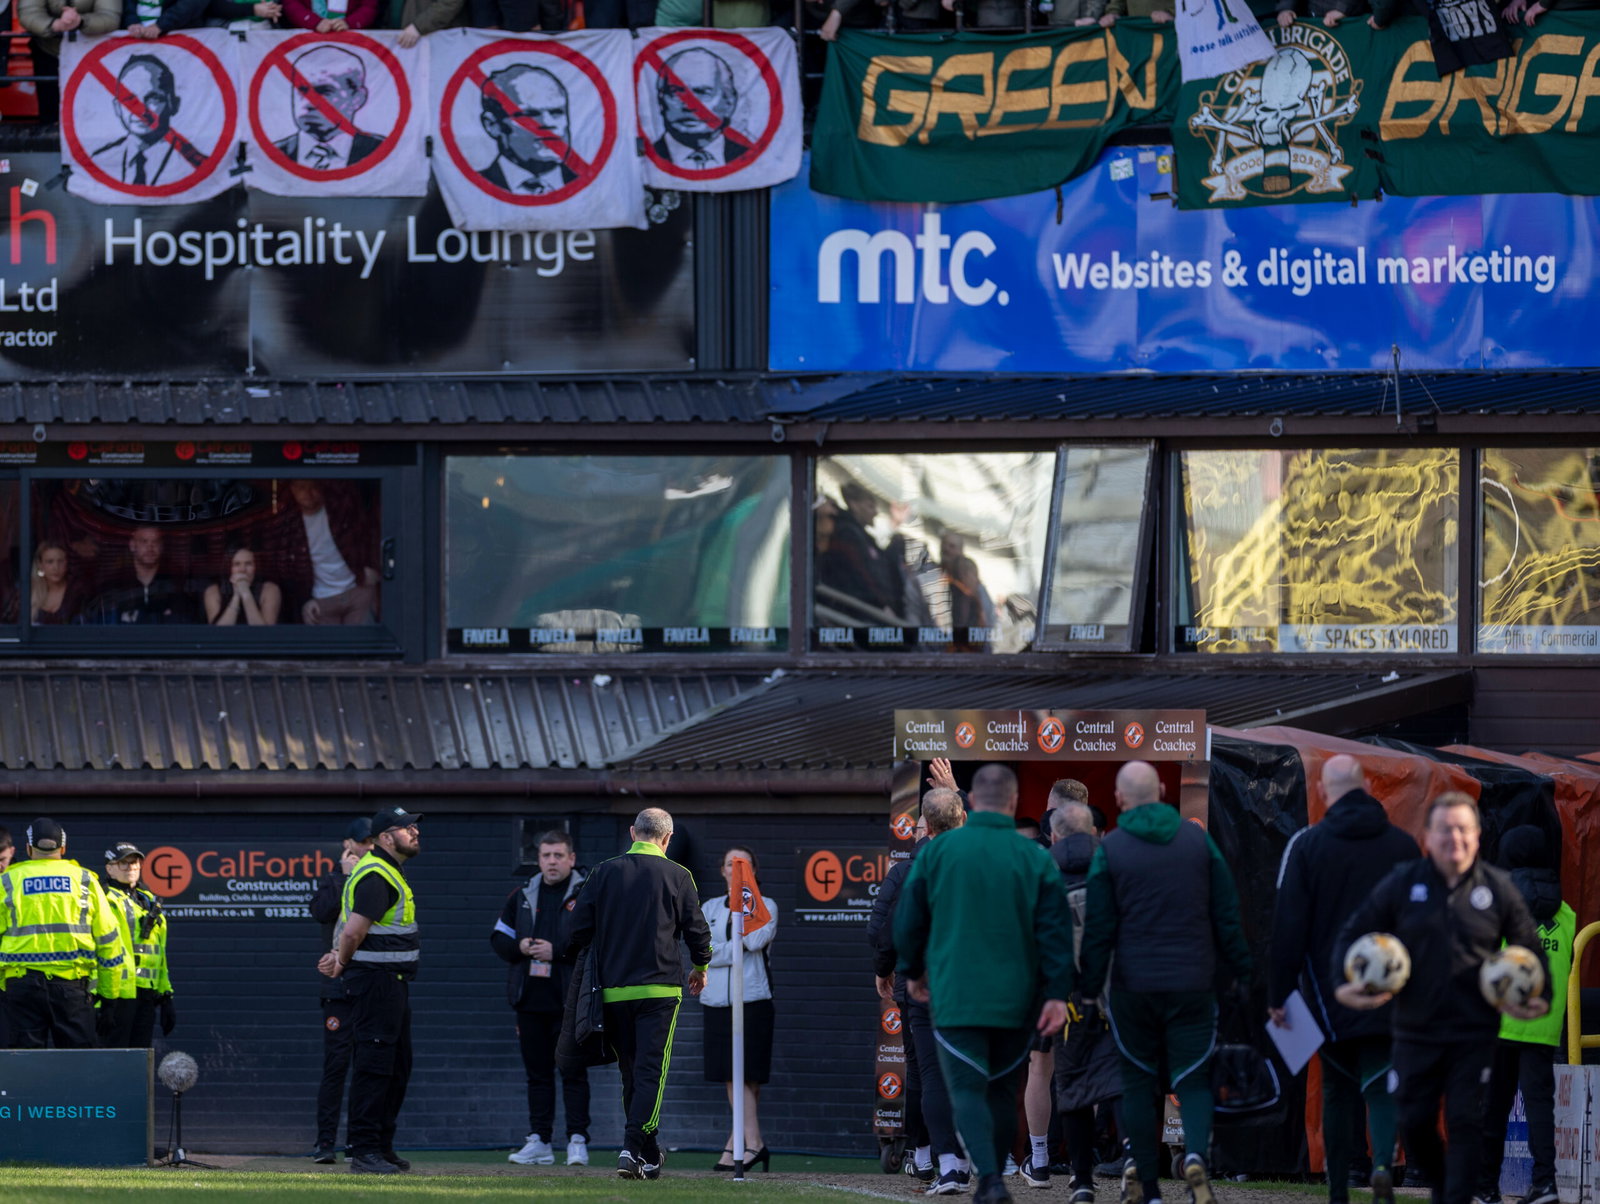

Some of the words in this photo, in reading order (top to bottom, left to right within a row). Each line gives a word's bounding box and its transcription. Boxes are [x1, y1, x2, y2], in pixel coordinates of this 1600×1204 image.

[1280, 25, 1350, 85] BRIGADE
[857, 26, 1164, 147] GREEN
[104, 216, 387, 281] Hospitality
[407, 215, 597, 277] Lounge
[818, 204, 1010, 306] mtc.
[1052, 250, 1212, 290] Websites
[1222, 249, 1249, 287] &
[1257, 247, 1366, 296] digital
[1377, 245, 1557, 293] marketing
[0, 277, 59, 312] Ltd
[463, 628, 509, 644] FAVELA
[529, 628, 576, 644] FAVELA
[596, 628, 643, 644] FAVELA
[663, 627, 710, 643] FAVELA
[730, 627, 777, 643] FAVELA
[819, 627, 854, 643] FAVELA
[868, 627, 904, 643] FAVELA
[918, 627, 953, 643] FAVELA
[1070, 625, 1104, 641] FAVELA
[1325, 628, 1376, 649] SPACES
[1382, 628, 1449, 649] TAYLORED
[1505, 629, 1532, 648] Office
[1541, 629, 1598, 647] Commercial
[905, 720, 945, 734] Central
[987, 720, 1027, 734] Central
[1076, 720, 1115, 734] Central
[1155, 720, 1194, 734] Central
[904, 738, 947, 751] Coaches
[985, 738, 1029, 751] Coaches
[1073, 738, 1116, 752] Coaches
[1153, 738, 1196, 752] Coaches
[196, 850, 335, 878] CalForth
[845, 854, 889, 882] Cal
[25, 877, 70, 892] POLICE
[227, 879, 310, 891] Construction
[879, 1044, 905, 1053] Central
[877, 1054, 905, 1063] Coaches
[28, 1106, 117, 1119] WEBSITES
[876, 1109, 901, 1118] Central
[874, 1119, 902, 1128] Coaches
